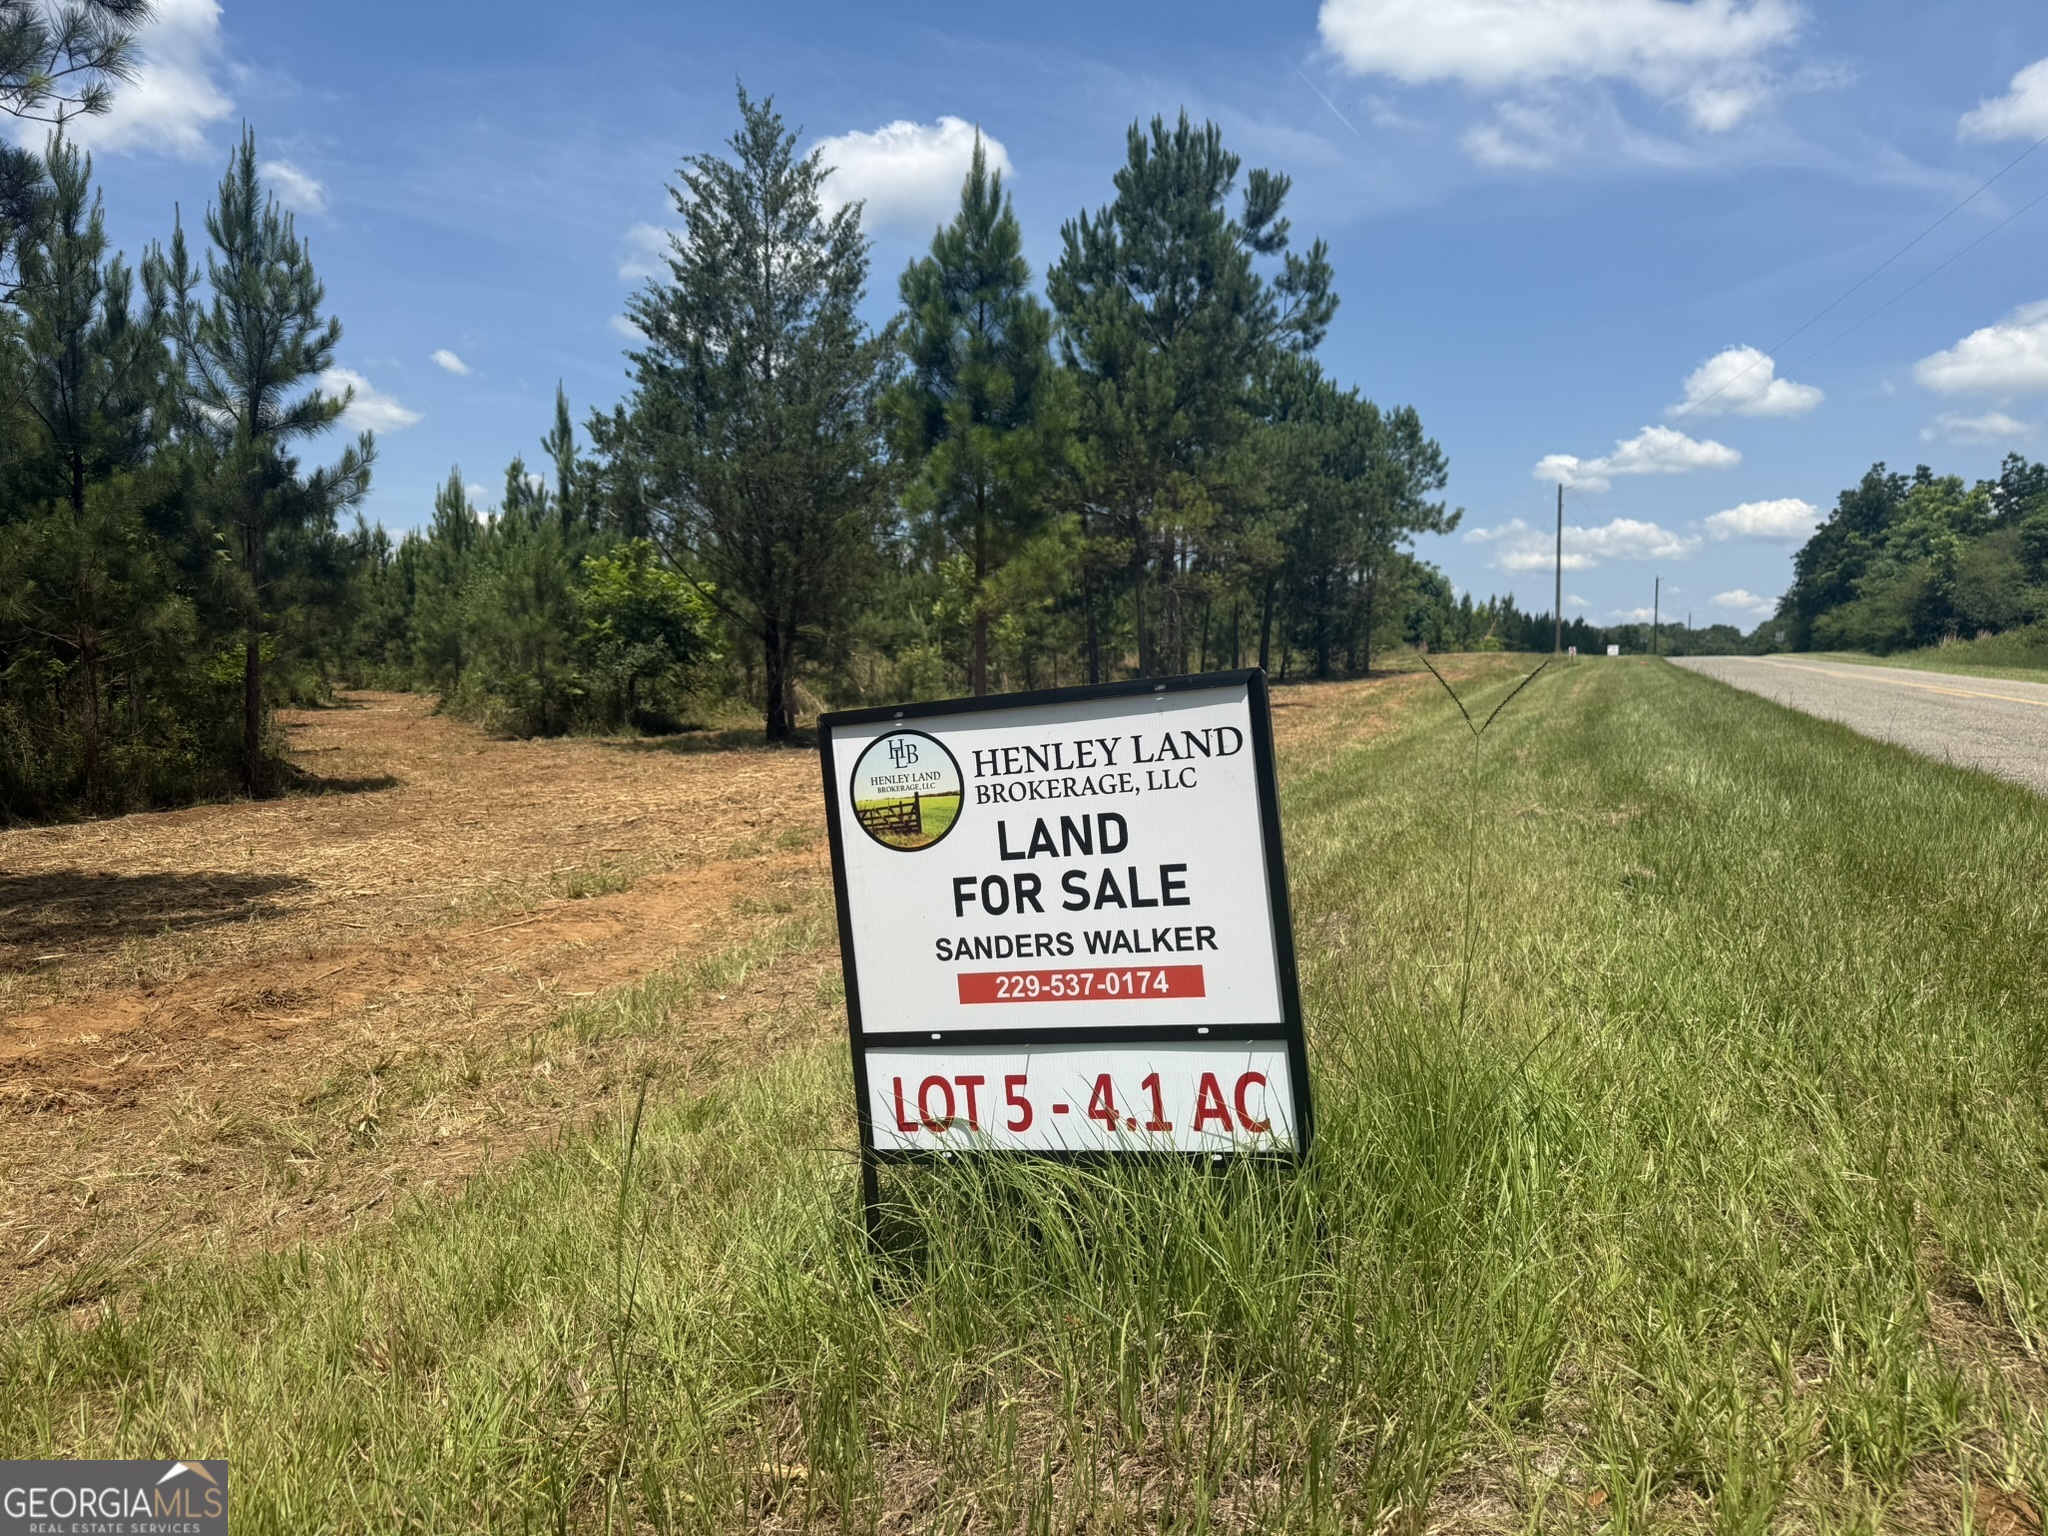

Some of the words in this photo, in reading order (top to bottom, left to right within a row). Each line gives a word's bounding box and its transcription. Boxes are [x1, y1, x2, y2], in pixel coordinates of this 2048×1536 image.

[972, 737, 1122, 778] HENLEY
[1131, 726, 1244, 764] LAND
[870, 773, 910, 786] HENLEY
[912, 771, 941, 782] LAND
[877, 784, 921, 794] BROKERAGE,
[922, 782, 936, 790] LLC
[975, 773, 1141, 805] BROKERAGE,
[1146, 767, 1198, 791] LLC
[997, 812, 1129, 861] LAND
[953, 872, 1045, 917] FOR
[1061, 863, 1191, 911] SALE
[935, 932, 1075, 961] SANDERS
[1083, 925, 1219, 955] WALKER
[995, 970, 1170, 998] 229-537-0174
[893, 1074, 985, 1133] LOT
[1004, 1074, 1034, 1132] 5
[1052, 1103, 1070, 1114] -
[1088, 1072, 1173, 1132] 4.1
[1193, 1071, 1271, 1134] AC
